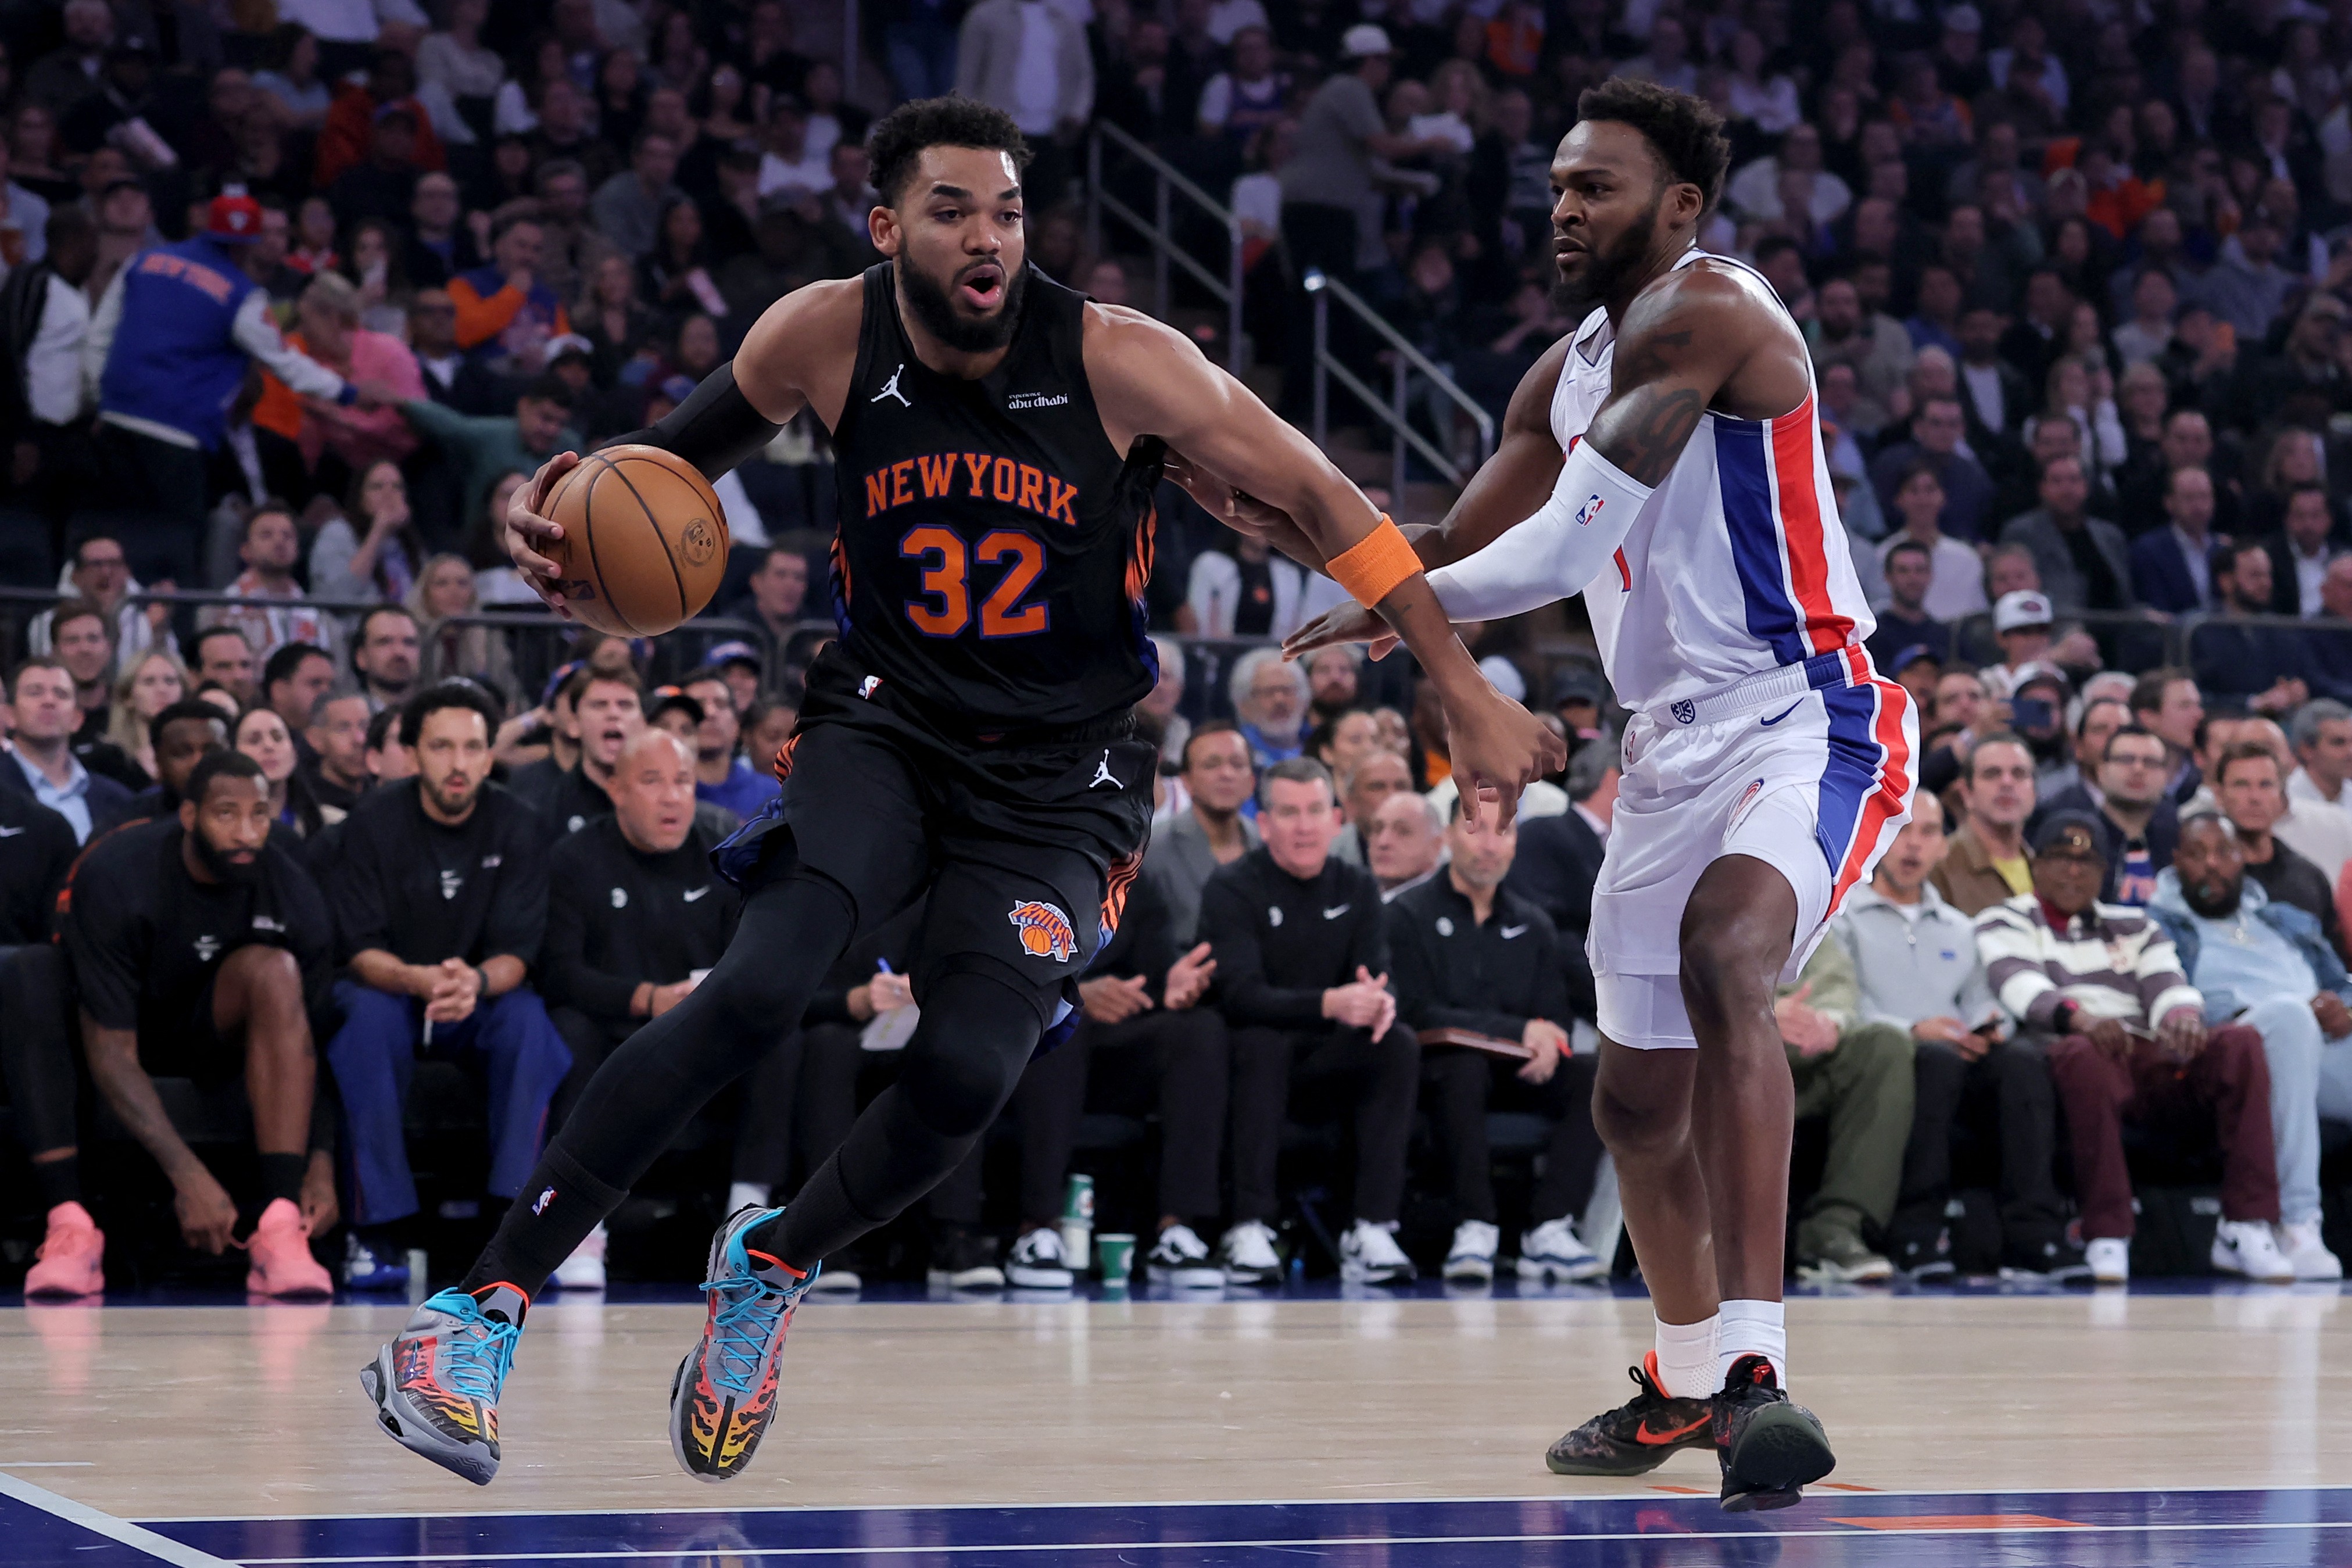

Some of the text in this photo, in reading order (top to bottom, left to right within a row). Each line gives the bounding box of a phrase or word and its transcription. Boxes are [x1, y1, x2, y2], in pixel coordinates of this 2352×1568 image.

[1008, 393, 1068, 409] abu dhabi
[865, 453, 1080, 526] NEW YORK
[899, 524, 1050, 640] 32
[1011, 903, 1072, 959] KNICKS
[1045, 904, 1069, 926] NEW YORK
